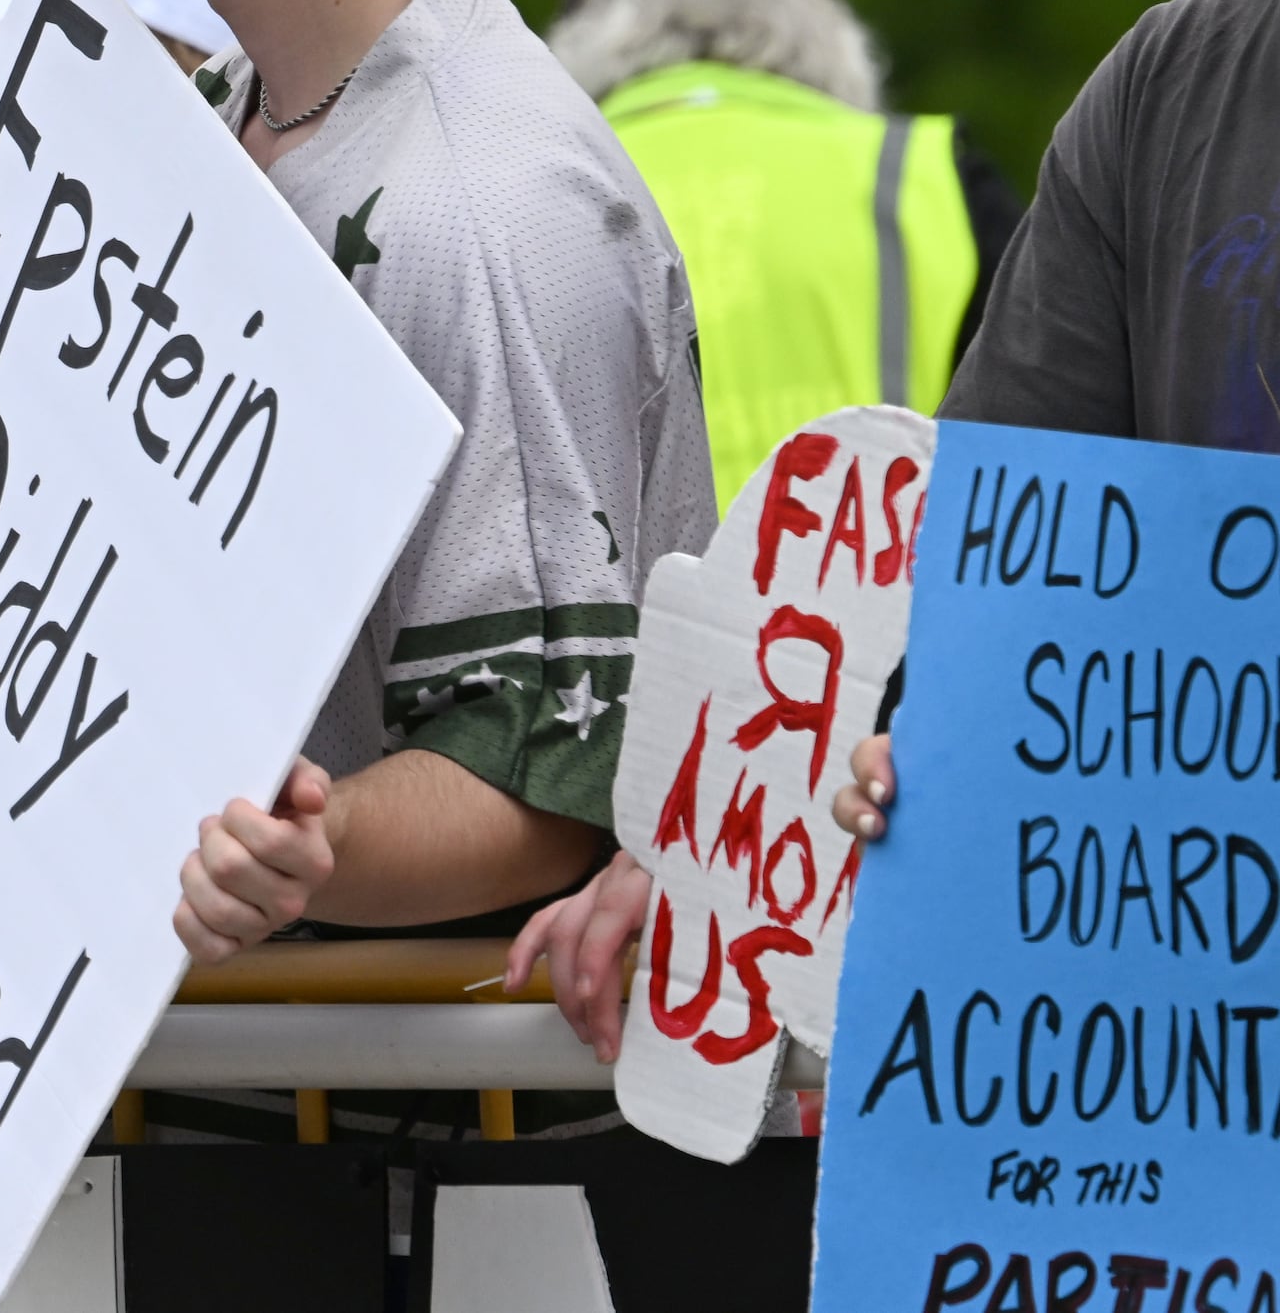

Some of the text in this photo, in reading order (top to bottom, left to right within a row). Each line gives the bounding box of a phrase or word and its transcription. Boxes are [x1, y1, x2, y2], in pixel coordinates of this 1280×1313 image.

[752, 432, 926, 596] FAS
[955, 465, 1280, 601] HOLD O
[1013, 641, 1280, 784] SCHOO
[1017, 815, 1280, 967] BOARD
[646, 887, 814, 1067] US
[856, 987, 1280, 1142] ACCOUNT
[985, 1148, 1164, 1207] FOR THIS
